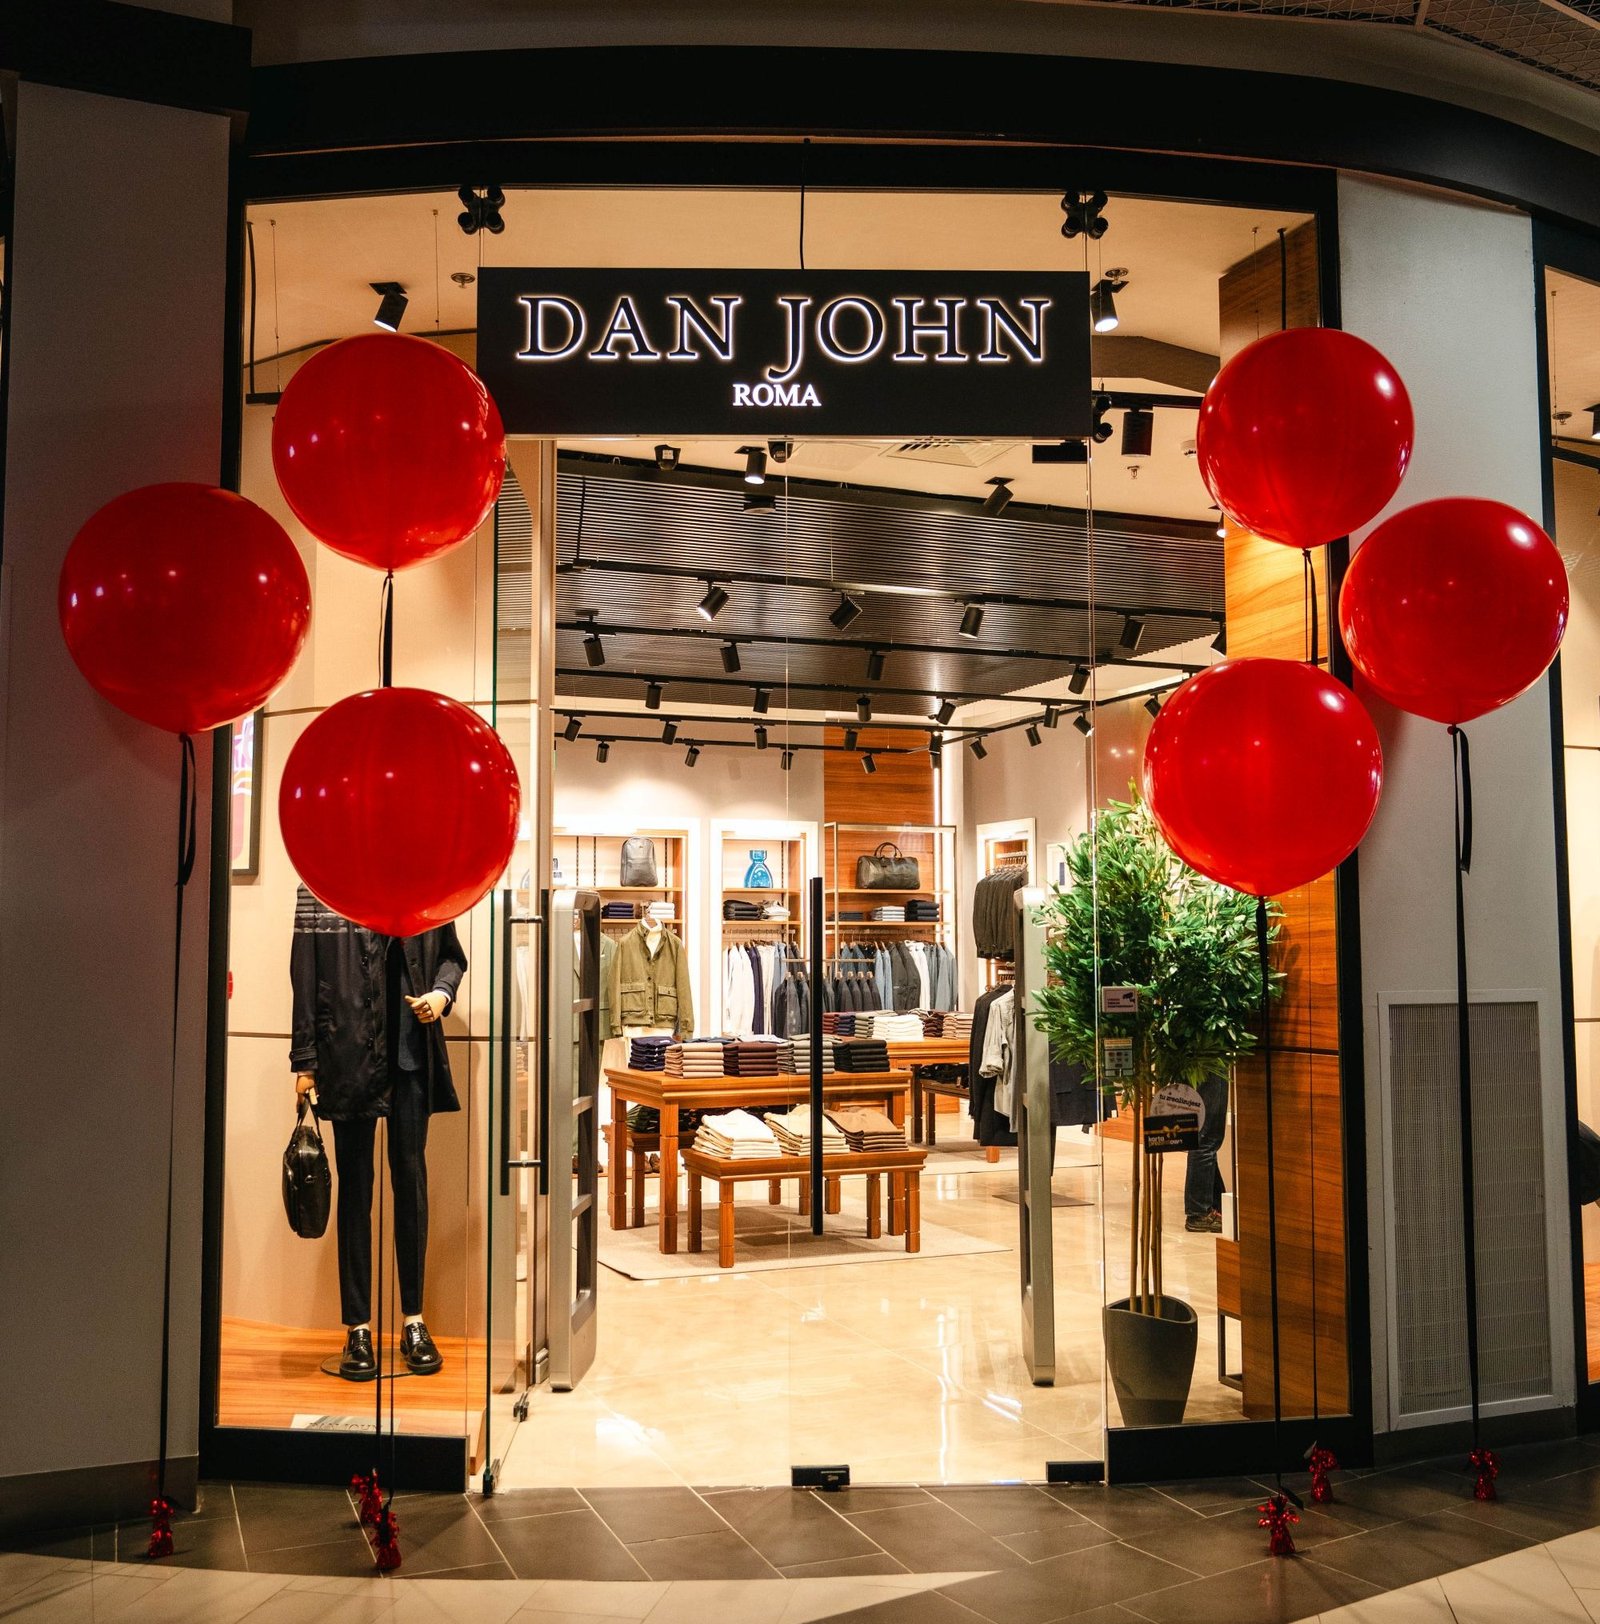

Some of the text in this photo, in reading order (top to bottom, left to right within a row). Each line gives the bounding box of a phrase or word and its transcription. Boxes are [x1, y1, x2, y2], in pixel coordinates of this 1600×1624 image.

[516, 294, 1052, 381] DAN JOHN
[732, 383, 823, 407] ROMA
